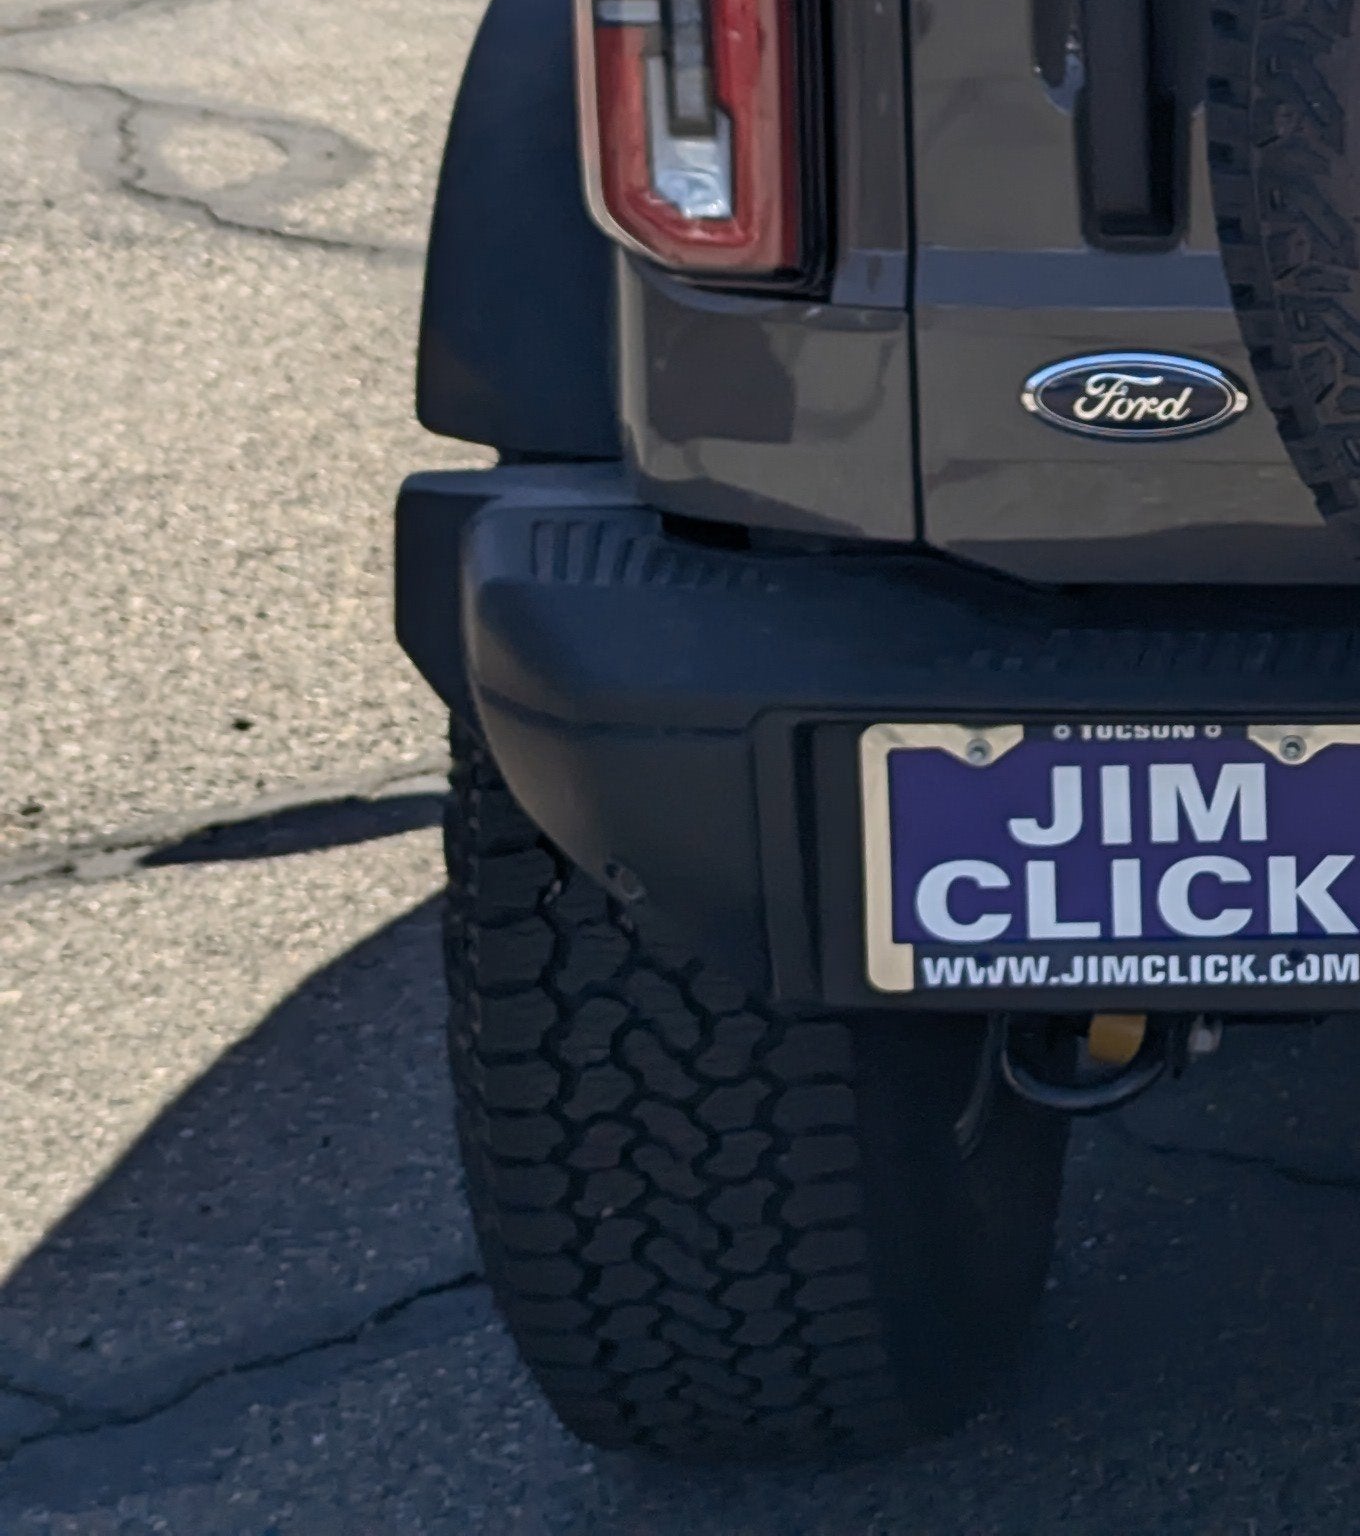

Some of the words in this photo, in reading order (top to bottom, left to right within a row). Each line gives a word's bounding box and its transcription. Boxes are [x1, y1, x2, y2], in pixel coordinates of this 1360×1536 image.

[1073, 372, 1194, 421] Ford
[1081, 724, 1196, 739] TUCSON
[1007, 762, 1269, 847] JIM
[914, 853, 1360, 943] CLICK
[922, 953, 1360, 986] WWW.JIMCLICK.COM
